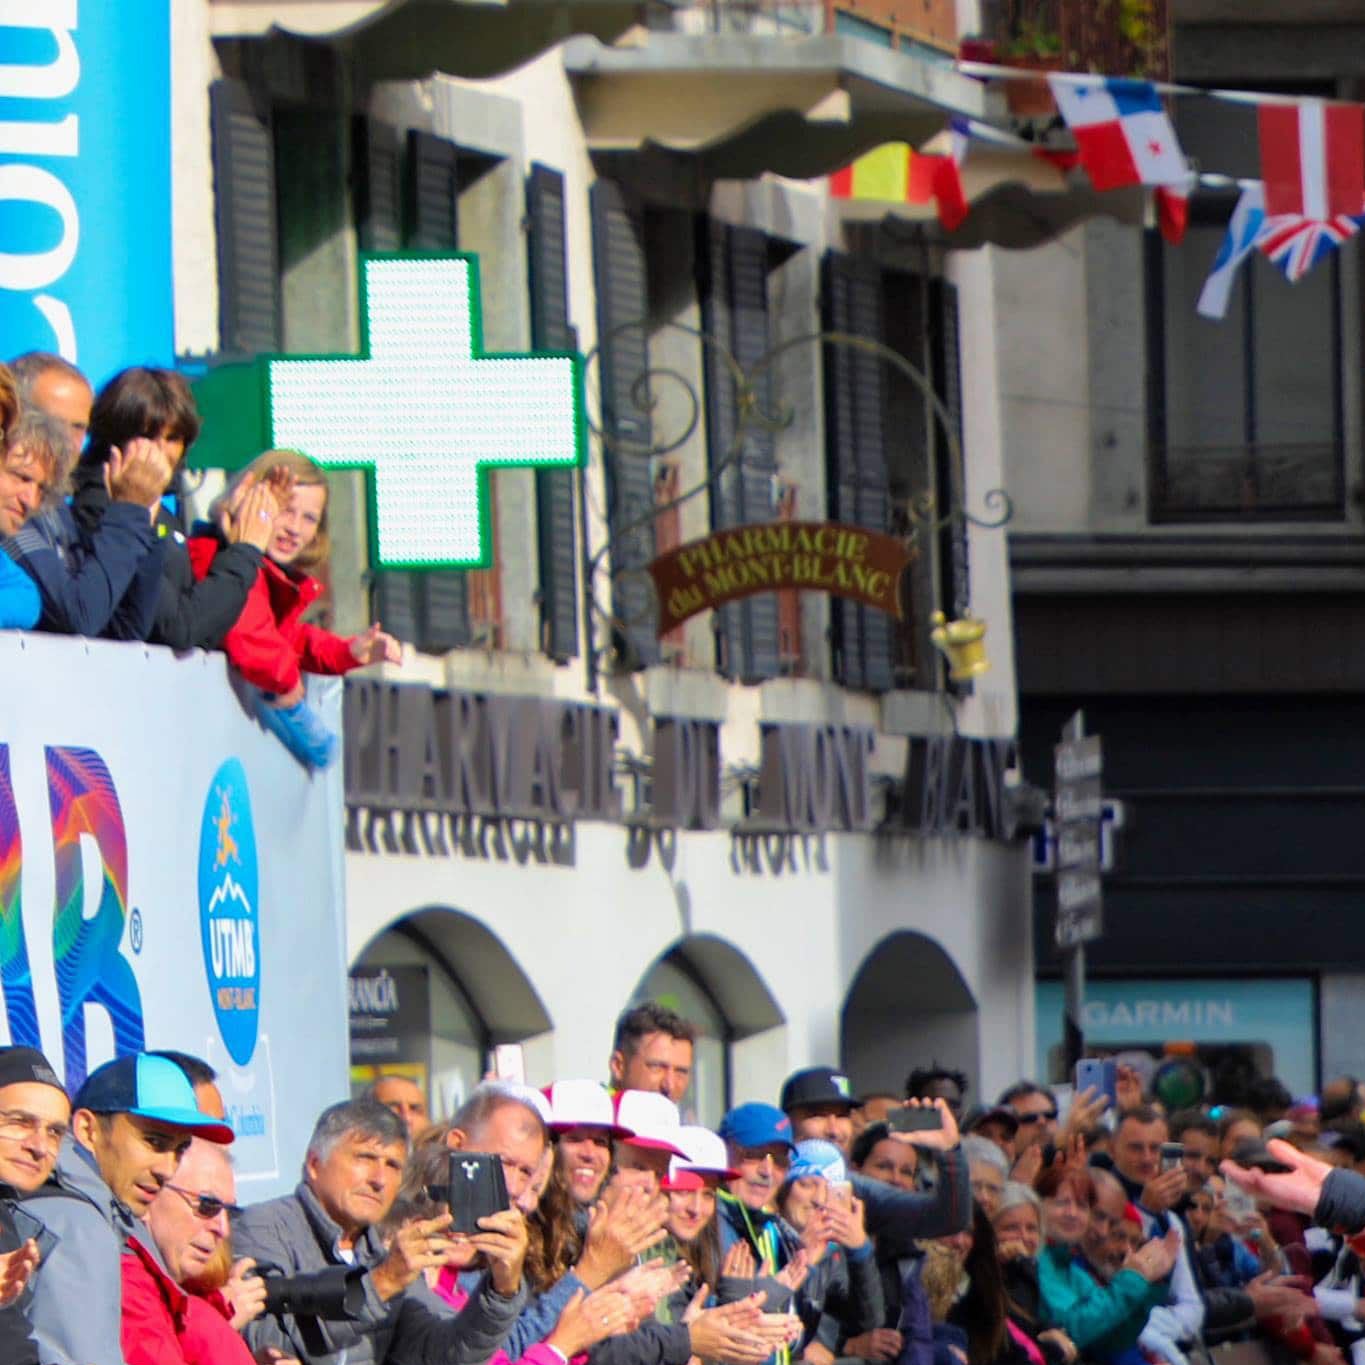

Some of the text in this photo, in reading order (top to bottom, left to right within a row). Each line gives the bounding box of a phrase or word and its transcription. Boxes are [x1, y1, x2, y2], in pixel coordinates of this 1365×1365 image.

[679, 526, 869, 578] PHARMACIE
[209, 918, 255, 979] UTMB
[1082, 1001, 1235, 1028] GARMIN
